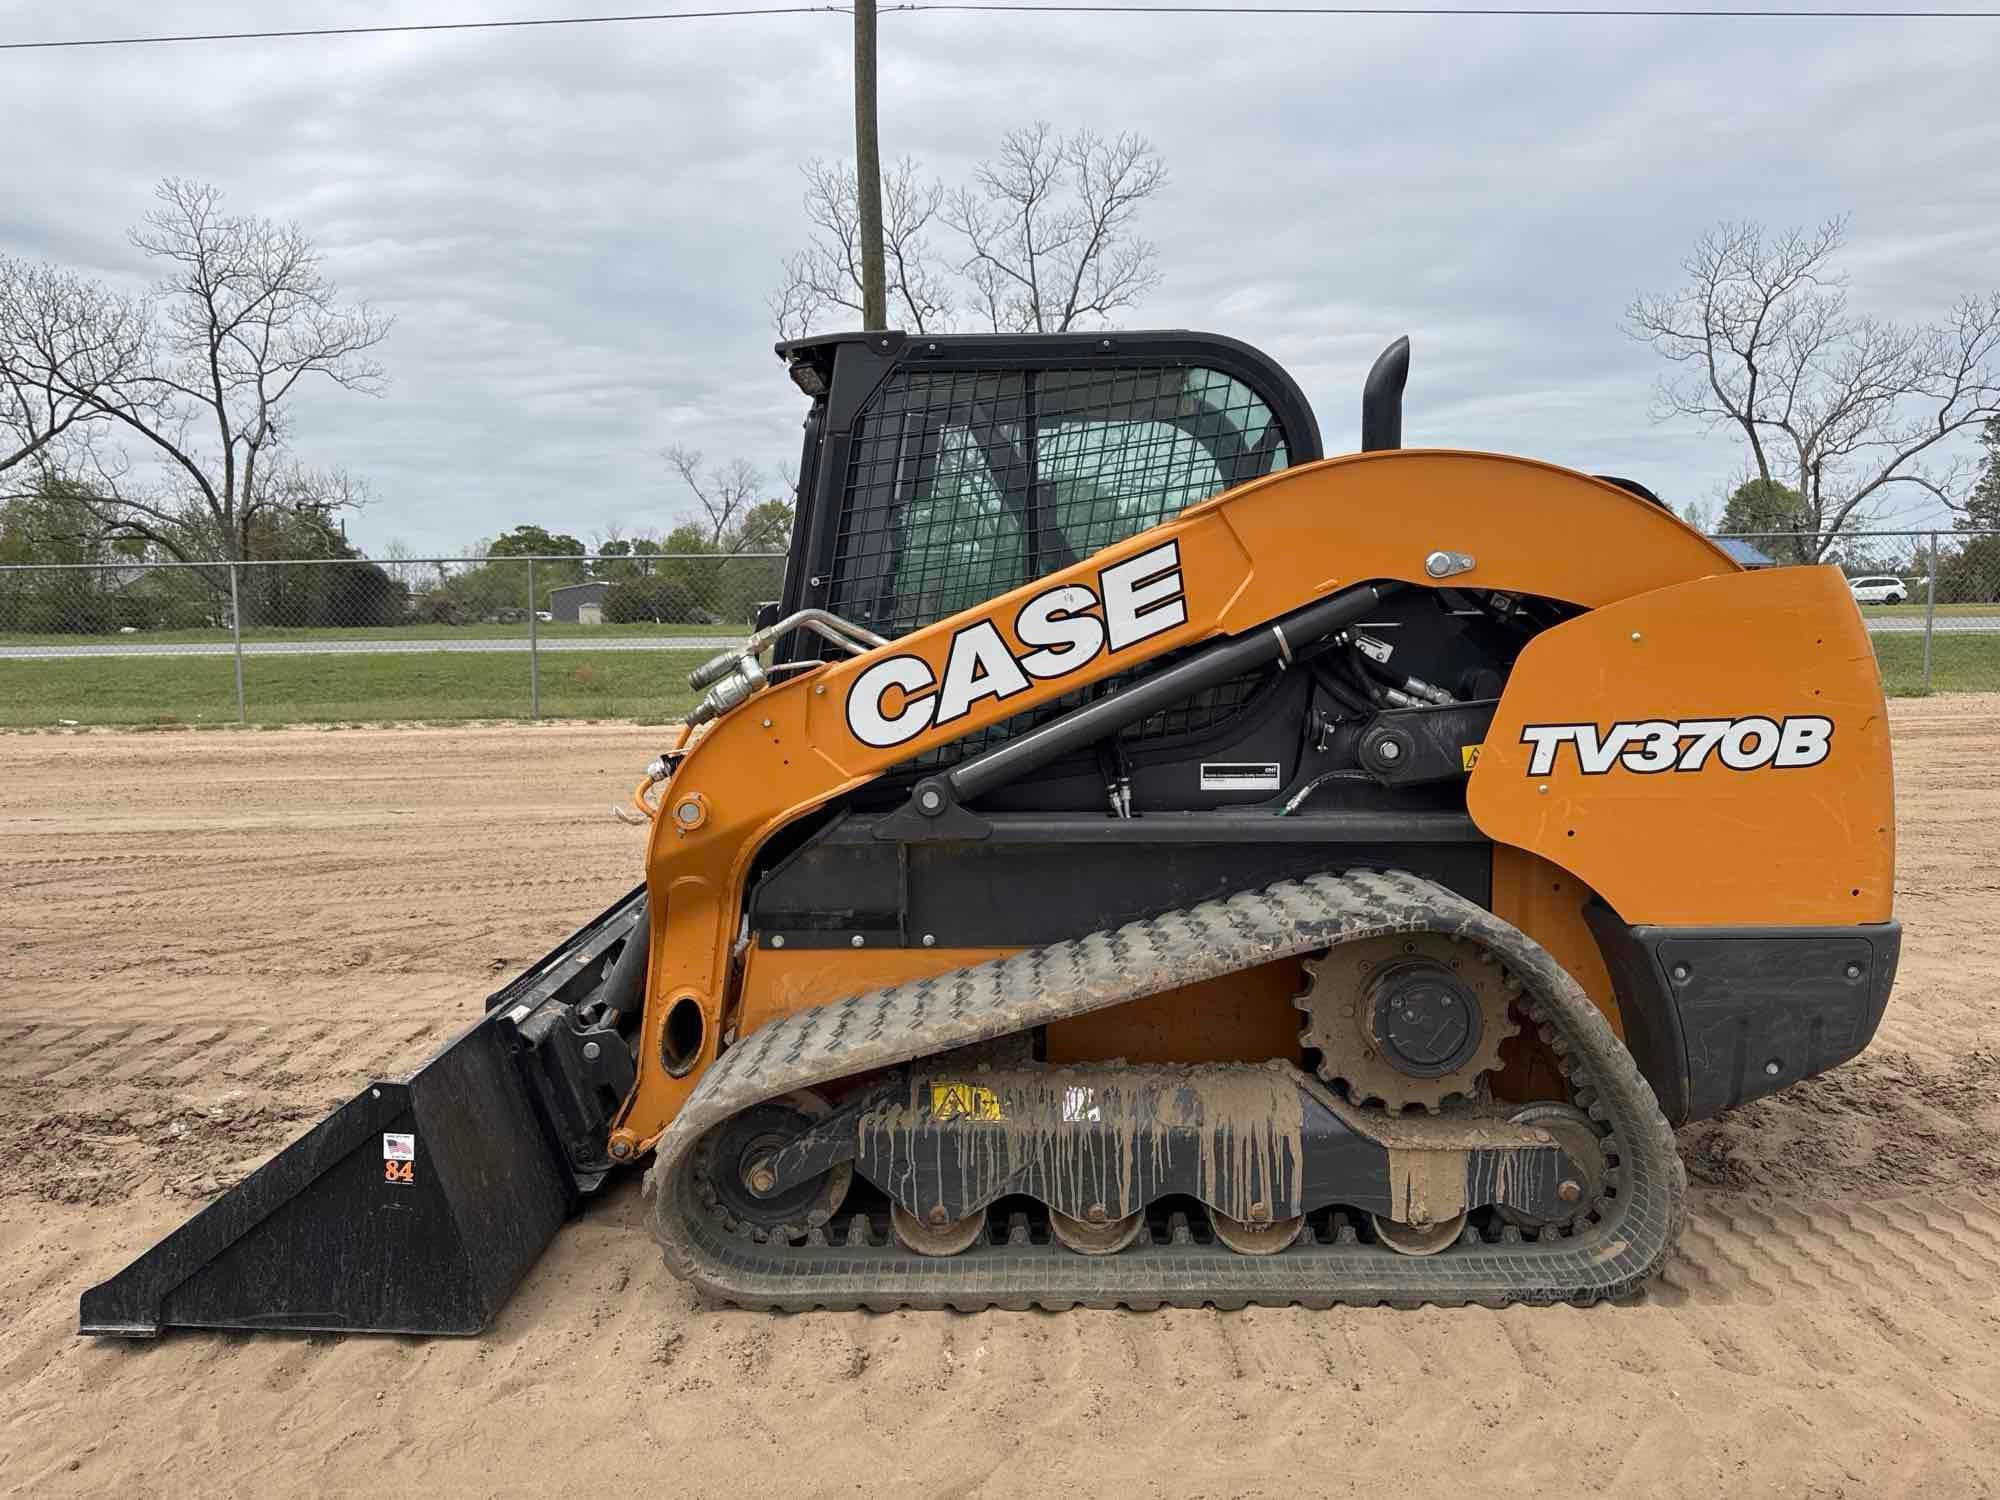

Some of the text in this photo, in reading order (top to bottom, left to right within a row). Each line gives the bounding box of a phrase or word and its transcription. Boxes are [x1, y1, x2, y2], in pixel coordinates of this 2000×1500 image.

[846, 538, 1187, 748] CASE
[1520, 715, 1833, 776] TV370B
[385, 1160, 414, 1182] 84
